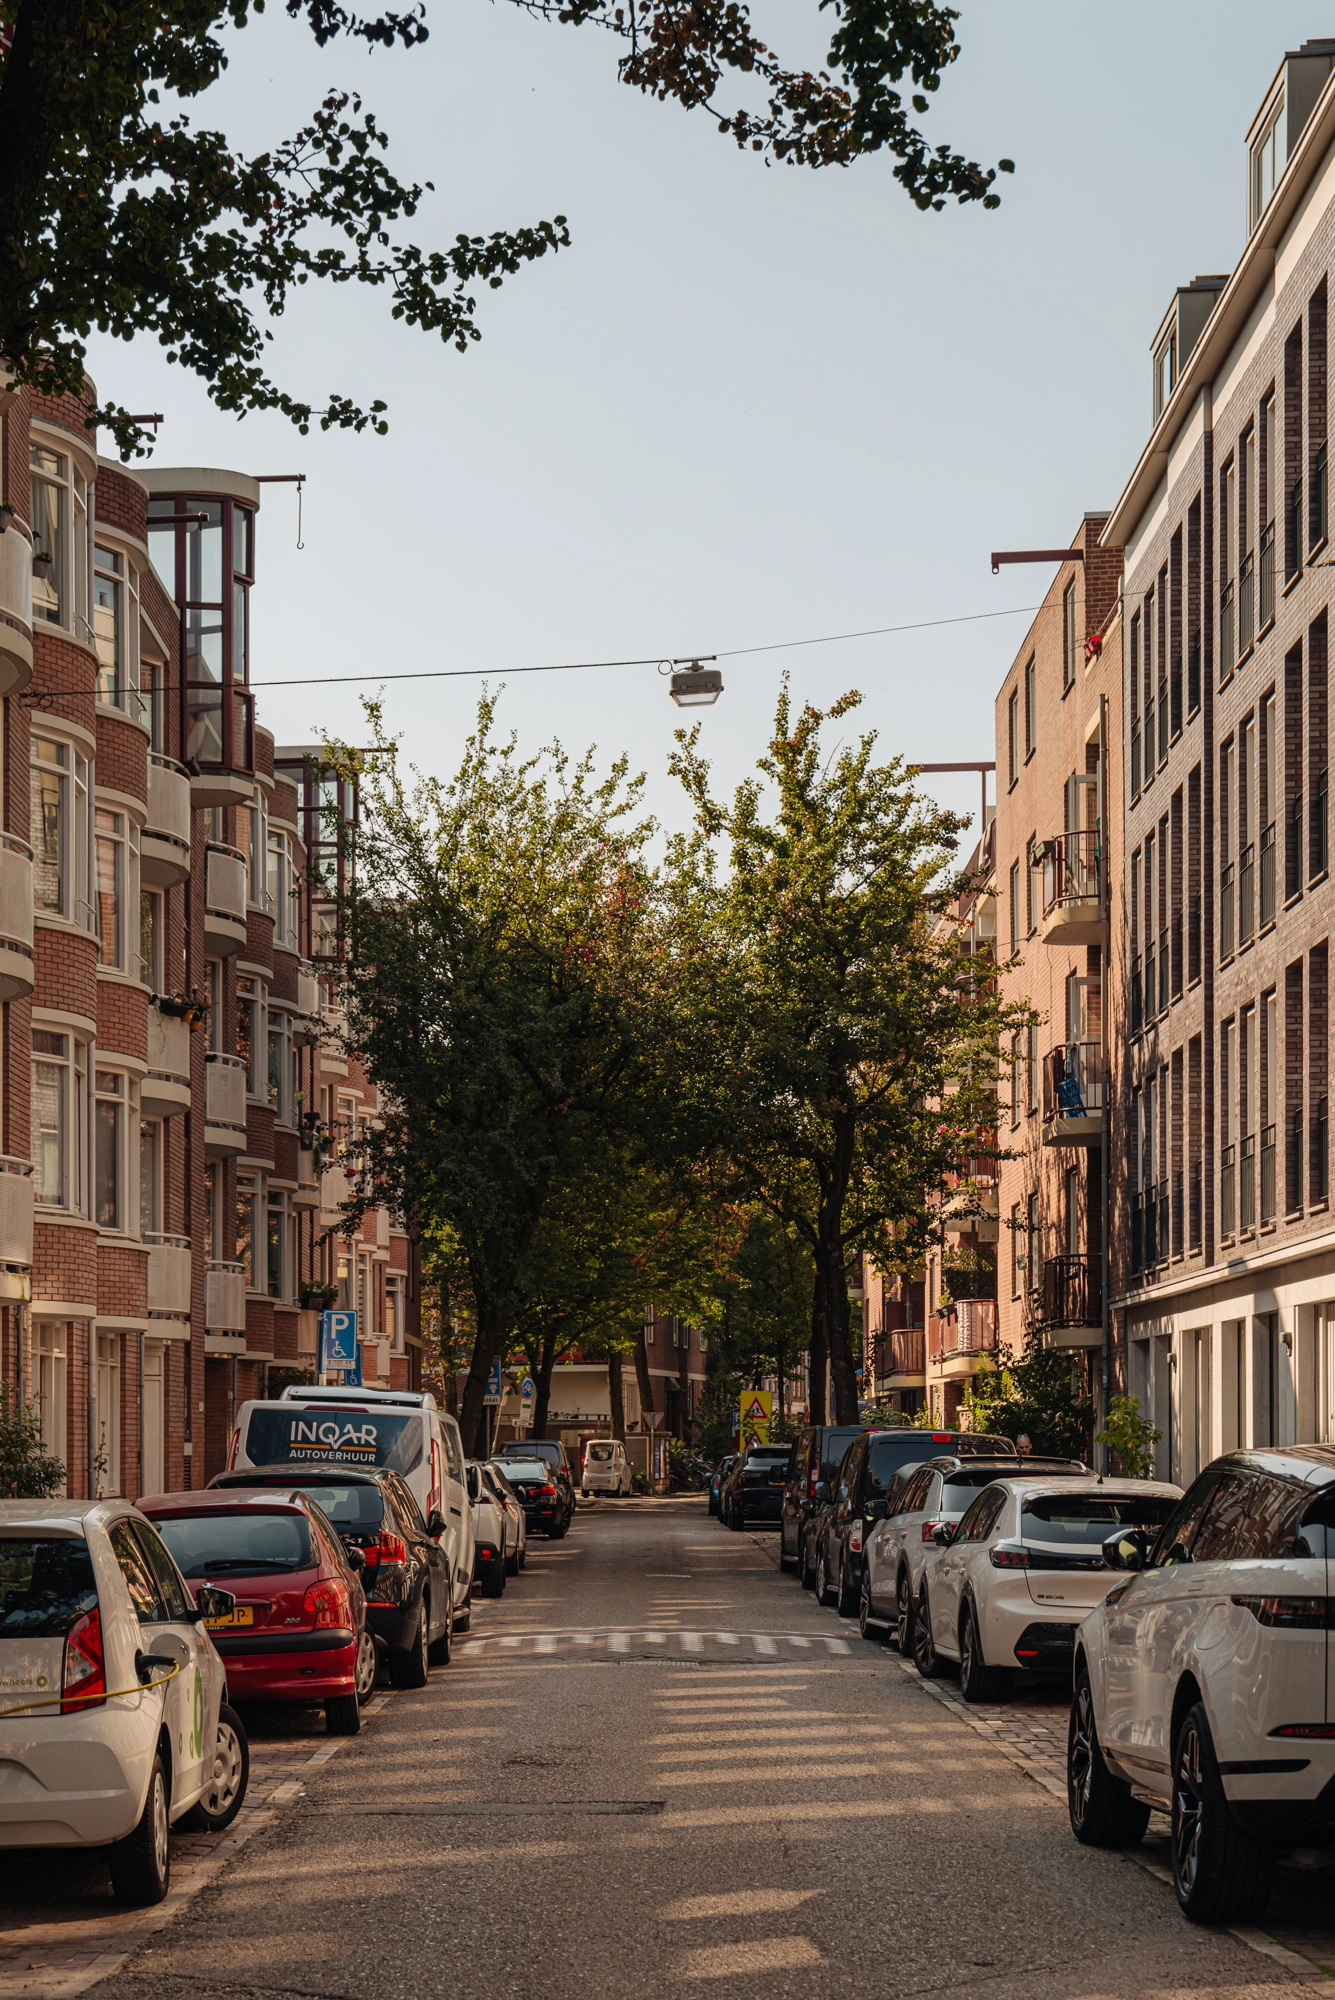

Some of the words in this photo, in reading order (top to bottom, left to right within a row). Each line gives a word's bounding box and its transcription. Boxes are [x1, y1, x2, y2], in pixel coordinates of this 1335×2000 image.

[331, 1314, 349, 1339] P
[290, 1421, 377, 1450] INQAR
[289, 1449, 376, 1462] AUTOVERHUUR
[283, 1616, 301, 1624] 206
[0, 1677, 33, 1687] wheels
